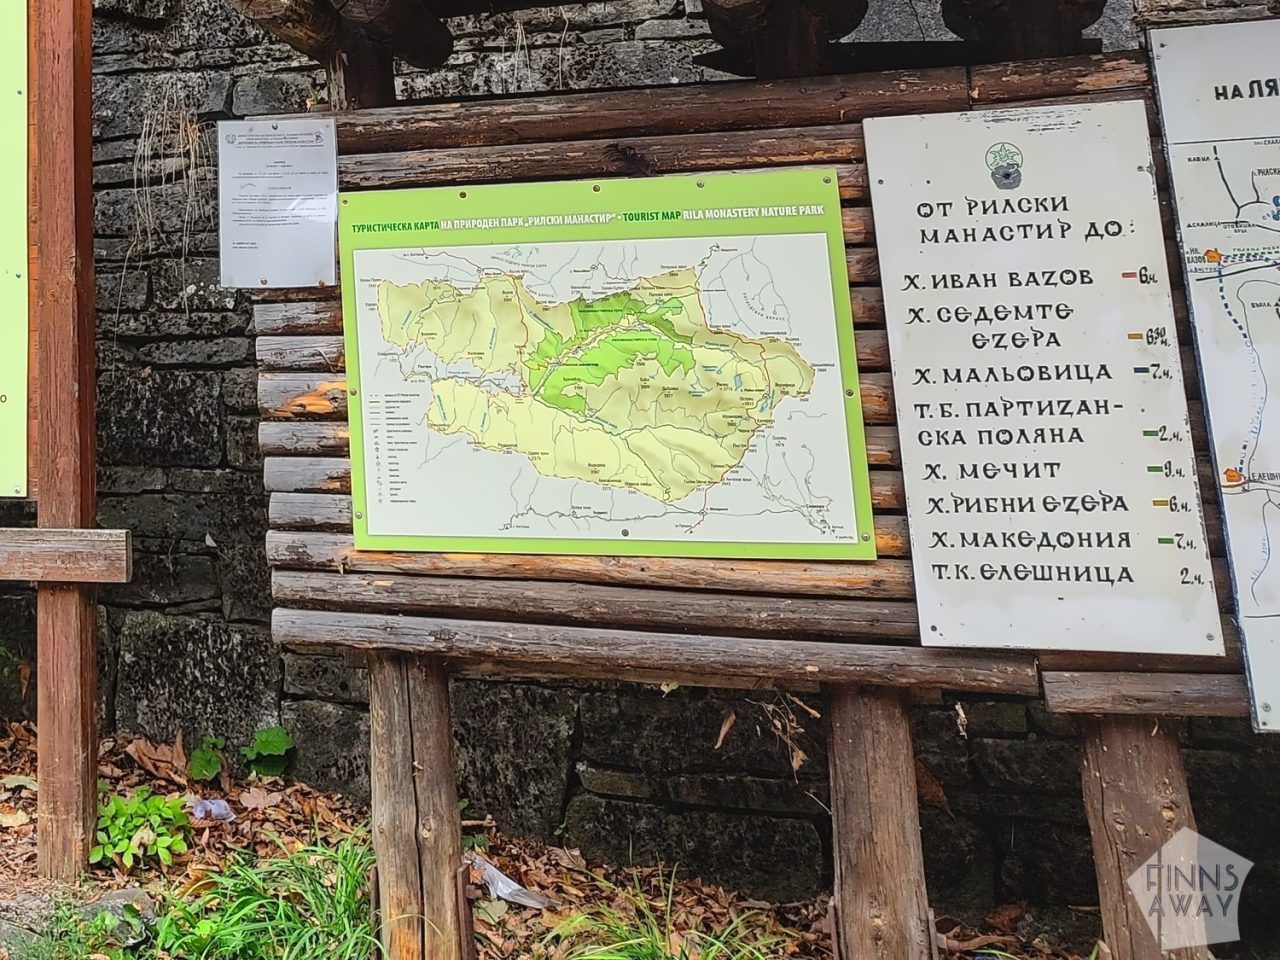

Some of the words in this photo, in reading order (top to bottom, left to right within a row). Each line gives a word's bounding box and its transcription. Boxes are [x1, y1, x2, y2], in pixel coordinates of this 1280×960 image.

[916, 201, 953, 218] ОТ
[964, 195, 1069, 216] РИЛСКИ
[352, 221, 412, 233] ТУРИСТИЧЕСКА
[414, 220, 439, 231] КАРТА
[440, 220, 453, 230] НА
[454, 218, 500, 229] ПРИРОДЕН
[501, 217, 524, 227] ПАРК
[623, 211, 659, 222] TOURIST
[661, 211, 681, 220] MAP
[683, 210, 703, 220] RILA
[705, 207, 760, 219] MONASTERY
[761, 206, 797, 217] NATURE
[799, 205, 824, 215] PARK
[920, 218, 1072, 244] МАНАСТИР
[917, 429, 966, 446] СКА
[978, 427, 1084, 445] ПОЛЯНА
[959, 462, 1061, 480] МЕЧИТ
